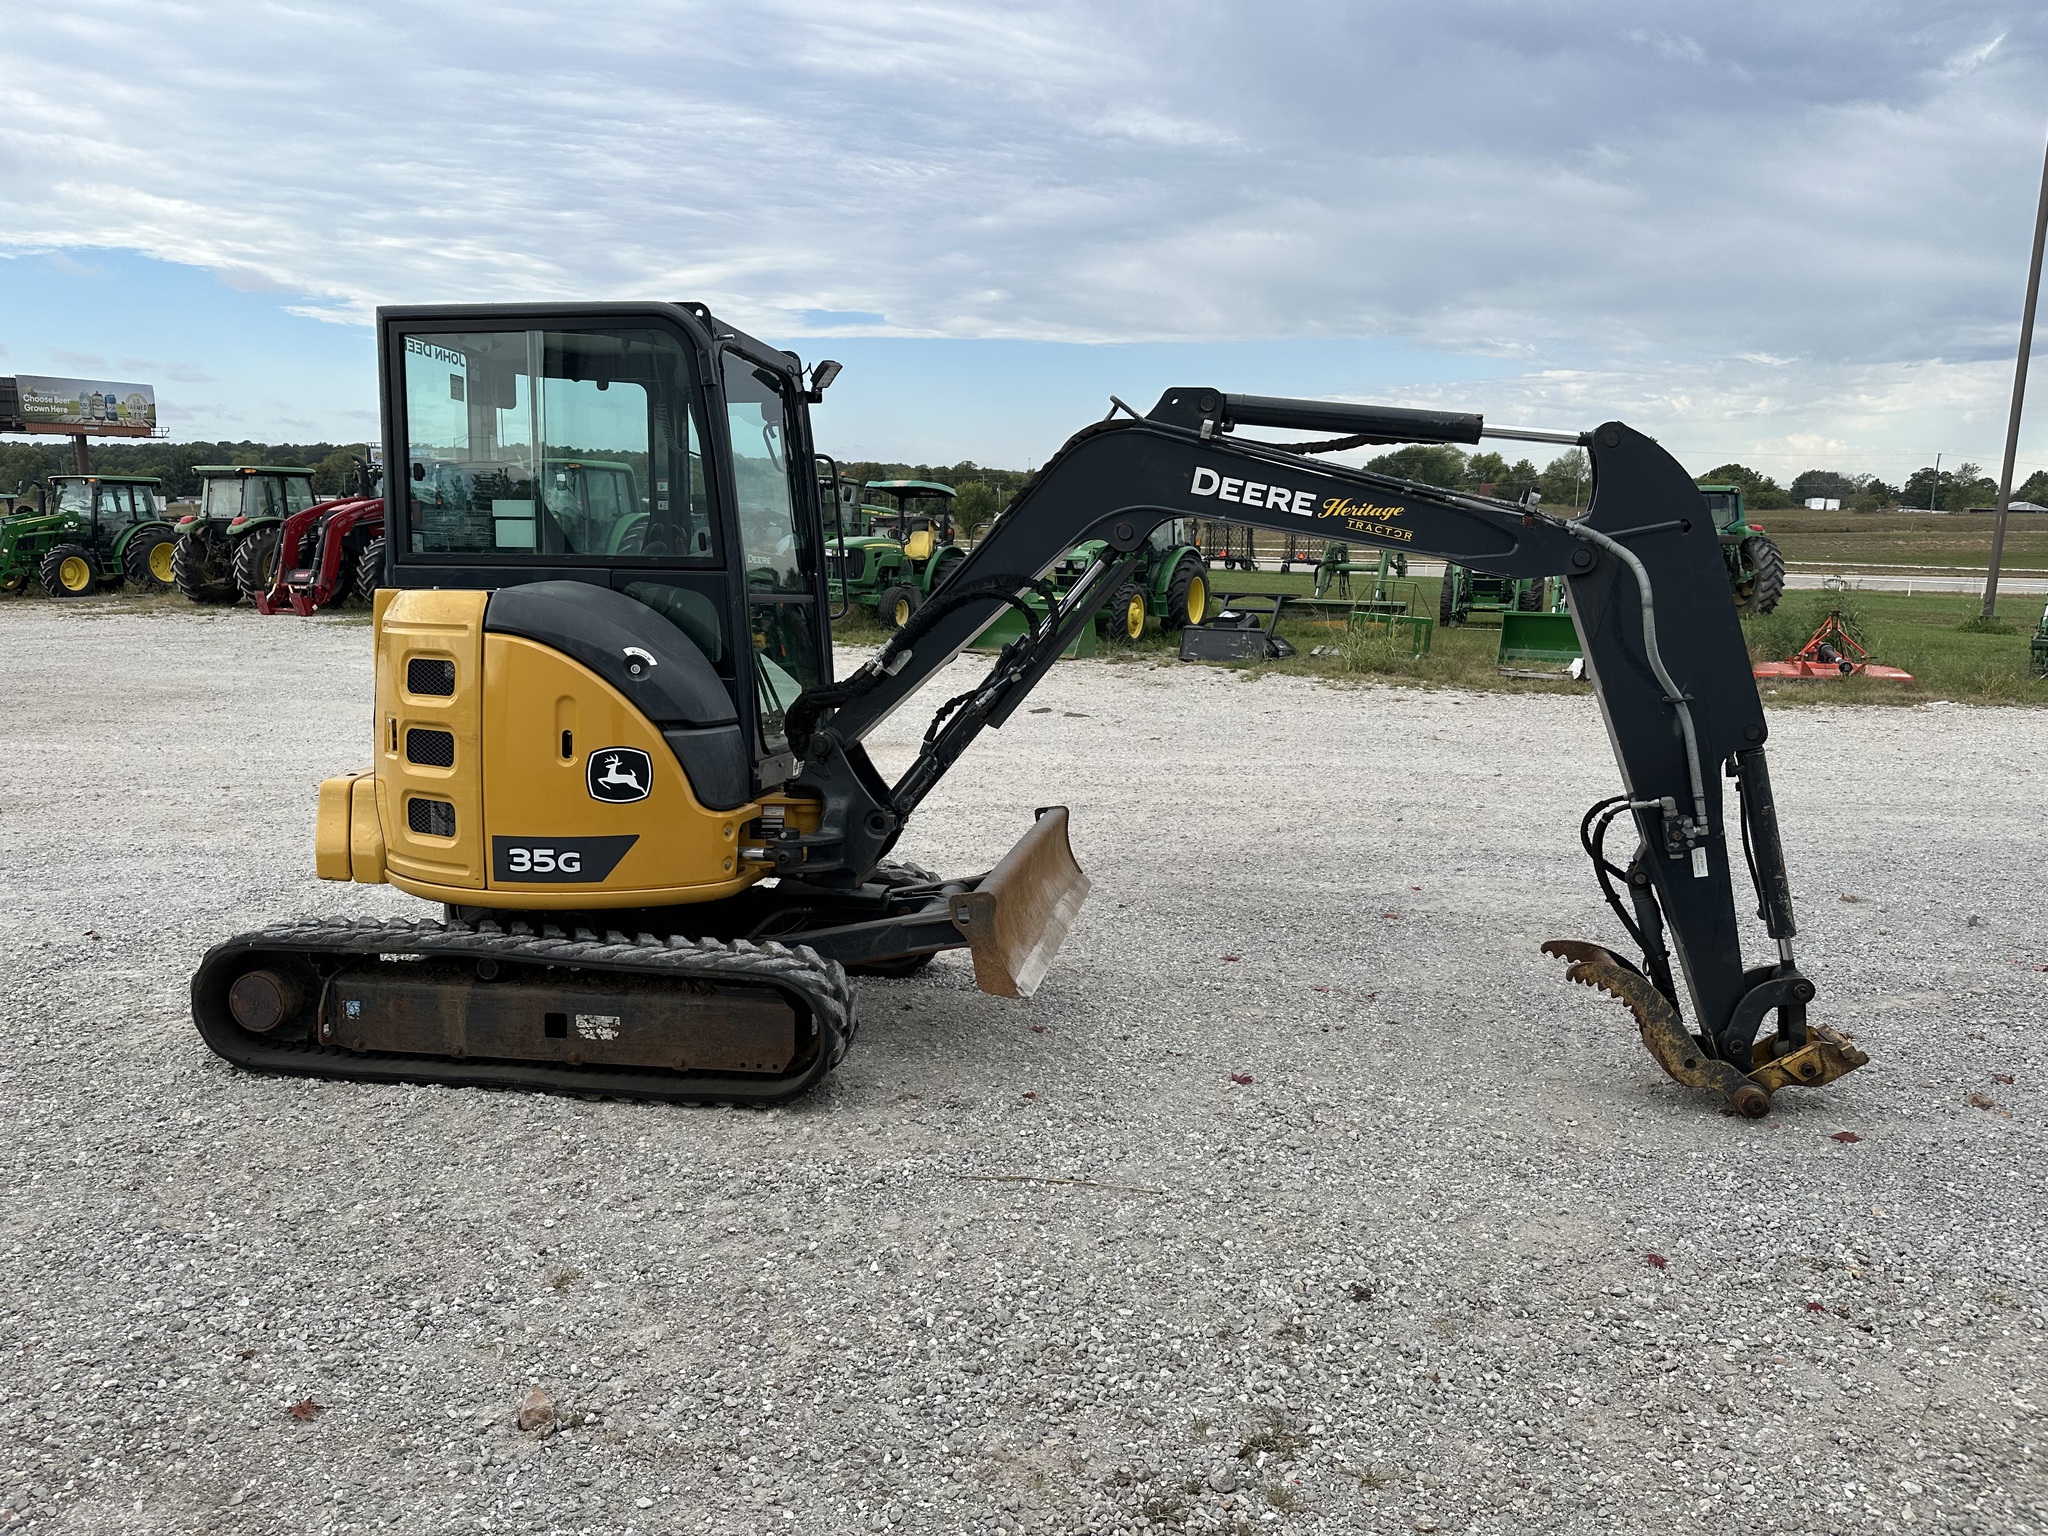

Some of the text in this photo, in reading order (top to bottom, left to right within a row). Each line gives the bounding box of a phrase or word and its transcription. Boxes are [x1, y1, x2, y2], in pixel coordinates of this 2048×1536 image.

[23, 394, 71, 404] Choose Beer
[24, 403, 69, 413] Grown Here
[1190, 466, 1317, 517] DEERE
[1317, 498, 1406, 521] Heritage
[1347, 519, 1413, 541] TRACTOR
[747, 553, 772, 565] DEERE
[509, 848, 581, 873] 35G
